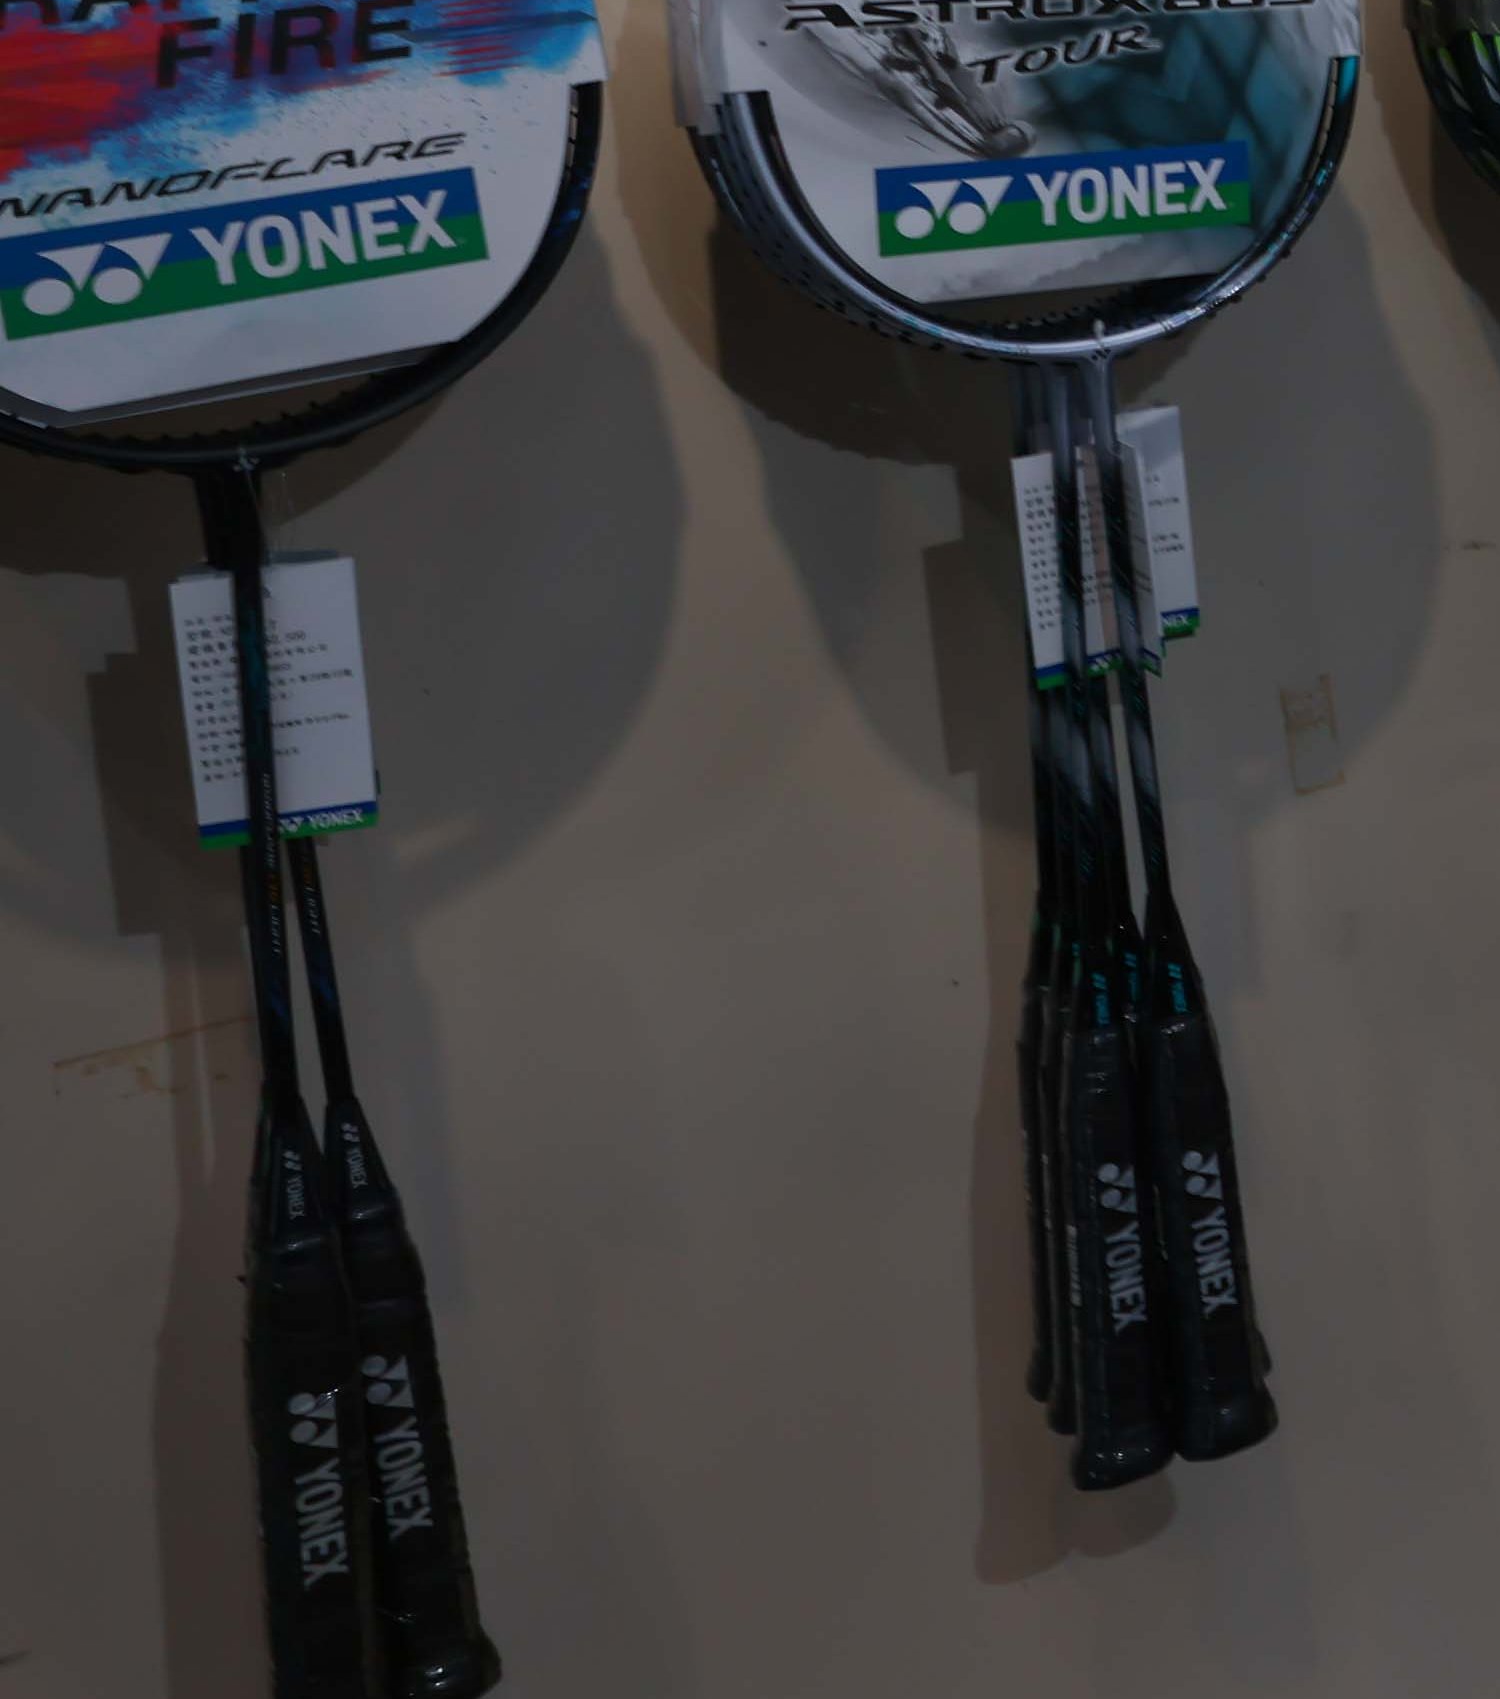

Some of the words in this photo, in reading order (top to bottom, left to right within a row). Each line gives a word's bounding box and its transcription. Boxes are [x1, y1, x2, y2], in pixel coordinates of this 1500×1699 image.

[966, 20, 1161, 86] TOUR
[188, 189, 461, 287] YONEX
[1026, 158, 1229, 227] YONEX
[308, 808, 365, 831] YONEX
[1103, 1220, 1149, 1335] YONEX
[1191, 1204, 1239, 1316] YONEX
[294, 1454, 349, 1590] YONEX
[373, 1413, 434, 1540] YONEX
